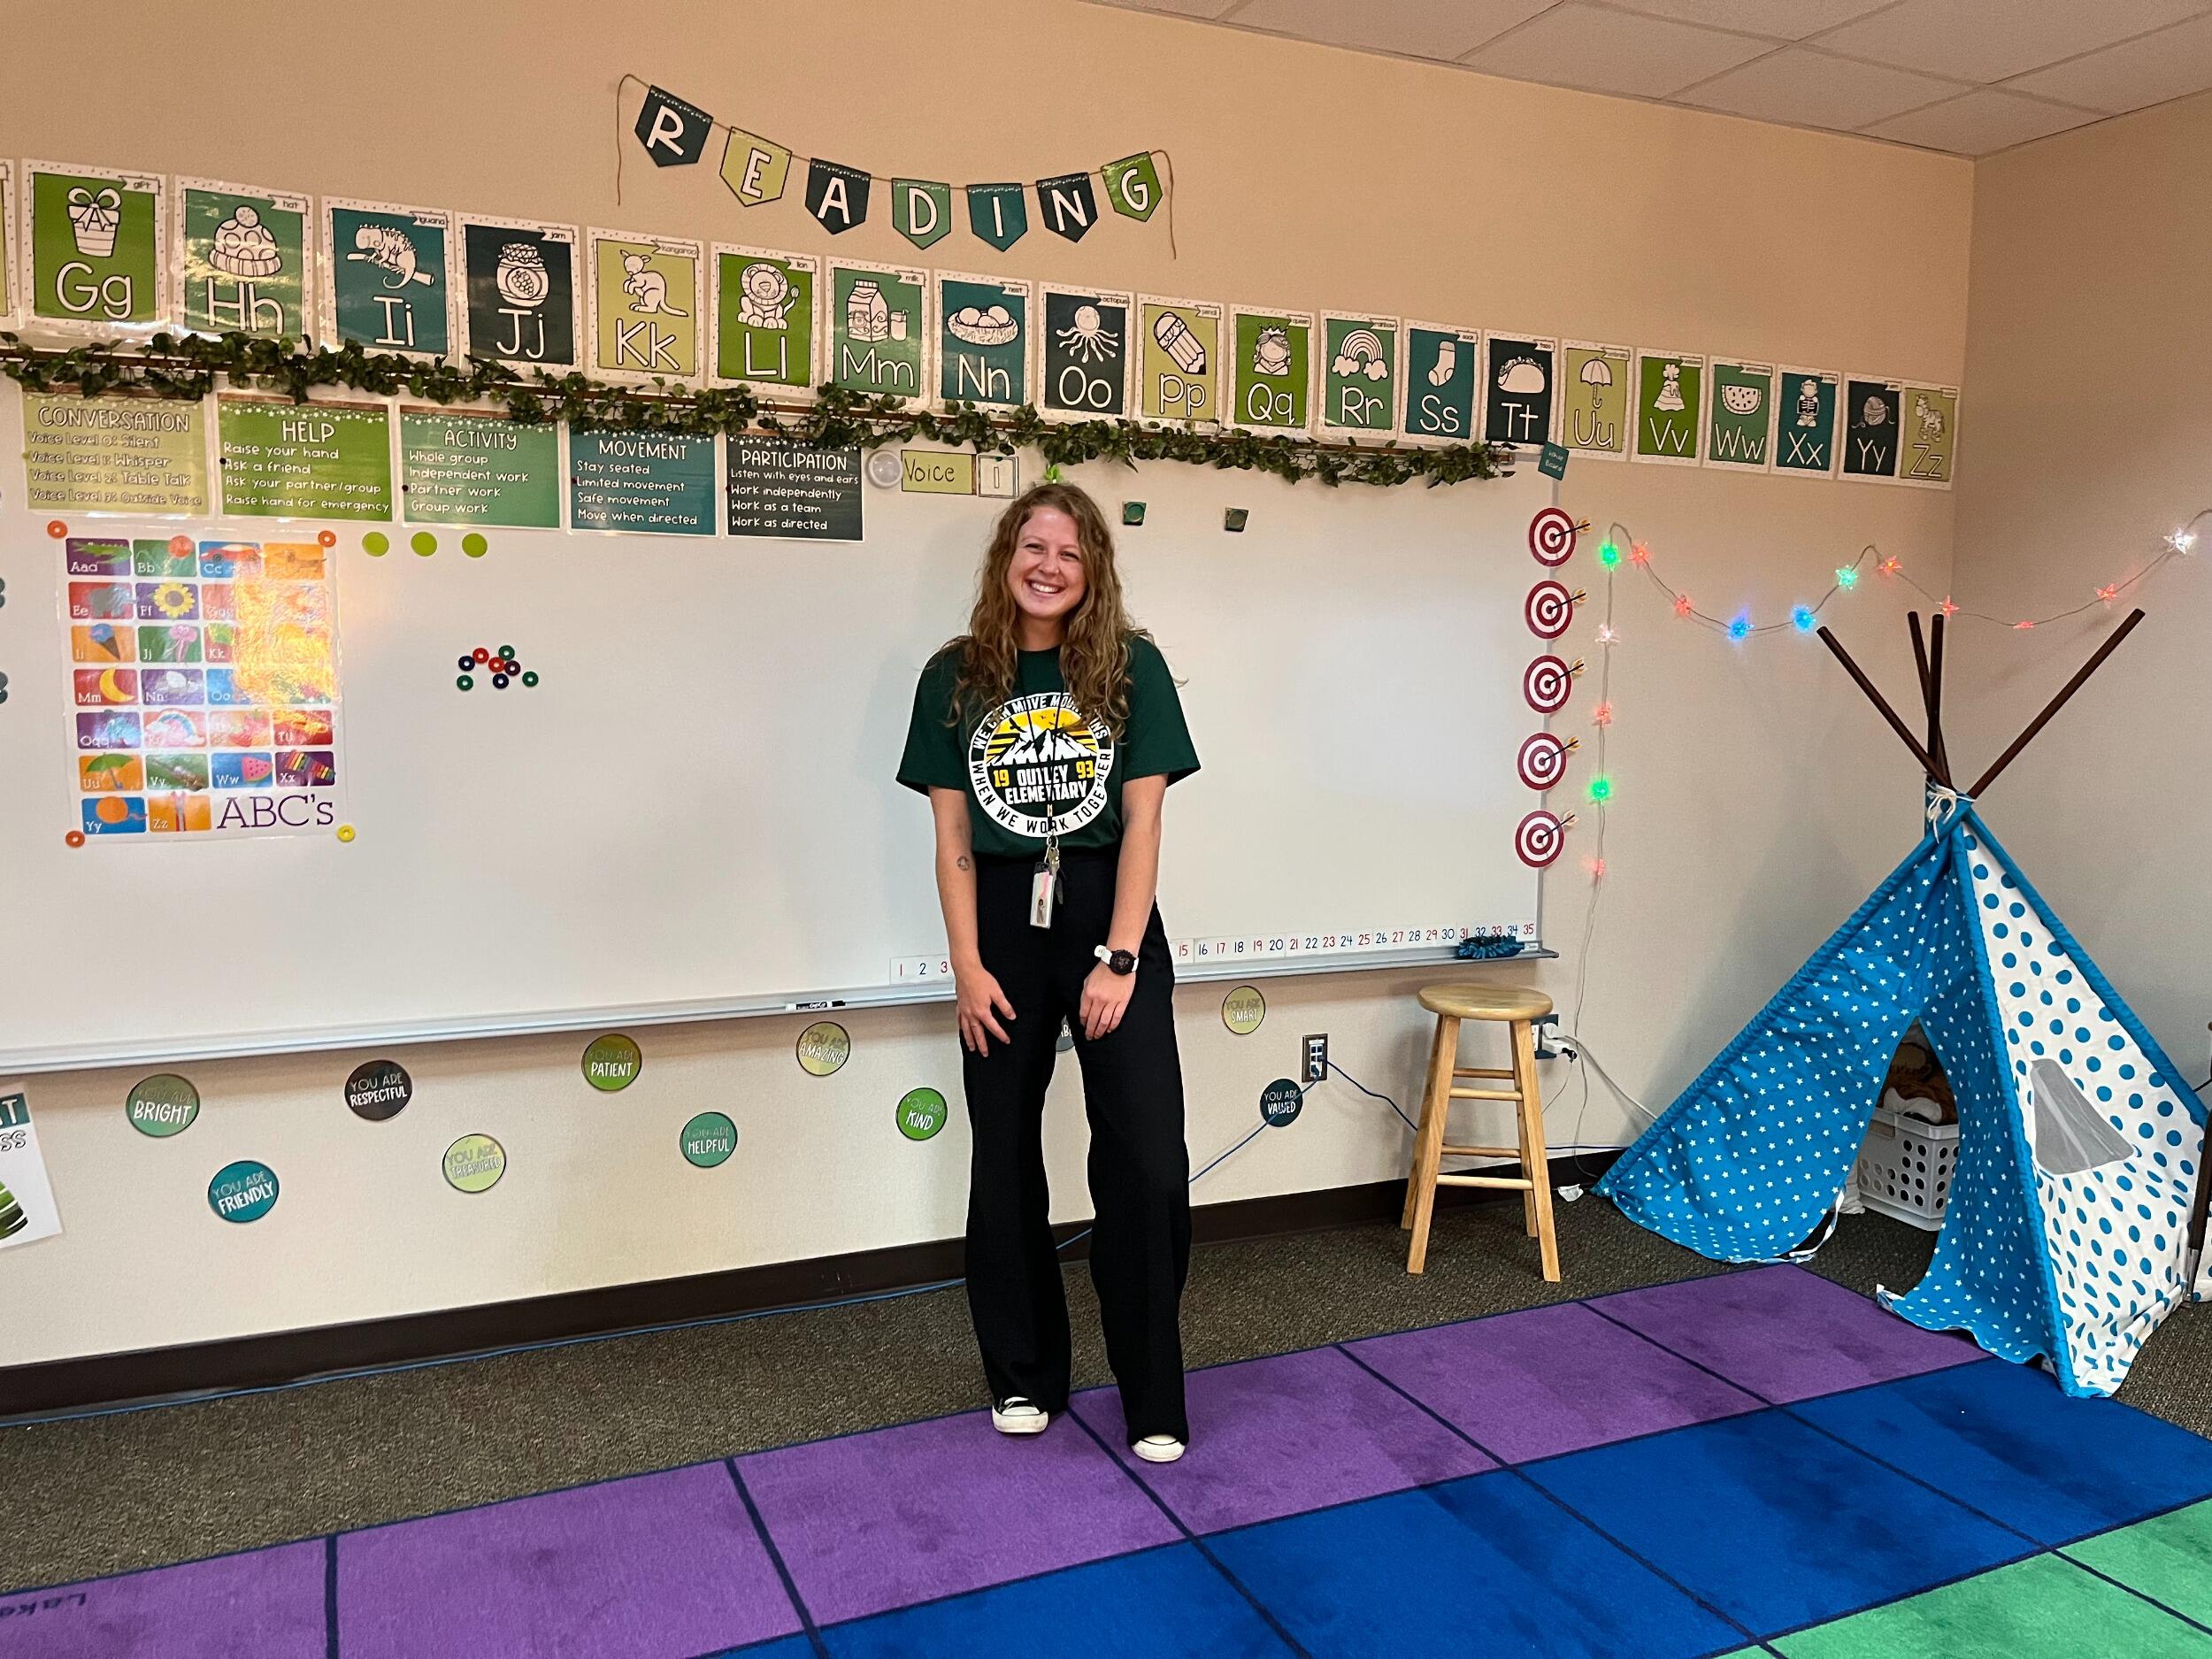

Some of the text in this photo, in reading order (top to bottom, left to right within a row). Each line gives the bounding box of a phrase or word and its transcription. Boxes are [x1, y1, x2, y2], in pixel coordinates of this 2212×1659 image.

[282, 200, 299, 210] hat
[419, 215, 446, 227] iguana
[550, 231, 566, 241] jam
[56, 262, 134, 320] Gg
[208, 276, 285, 334] Hh
[373, 296, 416, 347] Ii
[496, 308, 544, 359] Jj
[616, 318, 680, 371] Kk
[841, 343, 915, 388] Mm
[958, 353, 1010, 400] Nn
[1058, 365, 1112, 408] Oo
[1159, 373, 1206, 417] Pp
[1247, 382, 1294, 426] Qq
[1341, 385, 1384, 426] Rr
[1419, 394, 1460, 433] Ss
[38, 406, 190, 432] CONVERSATION
[1501, 403, 1539, 441] Tt
[1573, 409, 1614, 448] Uu
[28, 432, 63, 445] Voice
[66, 433, 99, 446] Level
[121, 434, 159, 449] Silent
[281, 419, 335, 443] HELP
[444, 429, 517, 450] ACTIVITY
[1649, 417, 1689, 453] Vv
[224, 442, 339, 459] Raise your hand
[599, 439, 687, 460] MOVEMENT
[1715, 423, 1765, 460] Ww
[1786, 431, 1824, 466] Xx
[29, 450, 64, 464] Voice
[66, 451, 100, 465] Level
[114, 453, 170, 469] Whisper
[409, 449, 488, 466] Whole group
[741, 449, 848, 471] PARTICIPATION
[1857, 438, 1886, 472] Yy
[1909, 443, 1943, 477] Zz
[224, 458, 248, 471] Ask
[267, 461, 311, 474] friend
[409, 465, 529, 483] Independent work
[577, 460, 650, 474] Stay seated
[904, 458, 955, 482] Voice
[30, 468, 65, 482] Voice
[68, 470, 102, 483] Level
[121, 471, 159, 486] Table
[165, 472, 191, 487] Talk
[226, 475, 246, 487] Ask
[252, 480, 280, 489] your
[576, 475, 685, 492] Limited movement
[731, 468, 858, 485] Listen with eyes and ears
[30, 488, 65, 501] Voice
[68, 488, 102, 502] Level
[121, 491, 166, 505] Outside
[170, 494, 202, 507] Voice
[411, 482, 502, 497] Partner work
[731, 484, 841, 501] Work independently
[227, 494, 389, 513] Raise hand for emergency
[411, 500, 488, 513] Group work
[578, 492, 670, 507] Safe movement
[732, 500, 759, 511] Work
[764, 503, 777, 511] as
[792, 503, 821, 513] team
[578, 509, 697, 525] Move when directed
[732, 516, 827, 530] Work as directed
[137, 562, 155, 573] Bb
[204, 564, 222, 573] Cc
[73, 605, 88, 616] Ee
[143, 649, 152, 660] Jj
[209, 649, 226, 659] Kk
[78, 693, 102, 703] Mm
[973, 729, 991, 749] WE
[216, 774, 239, 785] Ww
[993, 769, 1010, 787] 19
[1075, 760, 1094, 780] 93
[972, 753, 1111, 833] WHEN WE WORK TOGETHER
[217, 794, 334, 829] ABC's
[86, 821, 102, 833] Yy
[152, 818, 168, 829] Zz
[1179, 923, 1534, 957] 15 16 17 18 19 20 21 22 23 24 25 26 27 28 29 30 31 32 33 34 35
[919, 962, 926, 975] 2
[941, 961, 948, 973] 3
[1231, 1009, 1258, 1023] SMART
[799, 1042, 846, 1065] AMAZING
[591, 1062, 633, 1077] PATIENT
[349, 1077, 378, 1092] YOU
[349, 1085, 408, 1107] RESPECTFUL
[1263, 1091, 1282, 1102] YOU
[134, 1101, 192, 1125] BRIGHT
[1267, 1101, 1296, 1116] VALUED
[905, 1110, 933, 1131] KIND
[687, 1138, 730, 1155] HELPFUL
[212, 1180, 242, 1198] YOU
[218, 1181, 274, 1216] FRIENDLY
